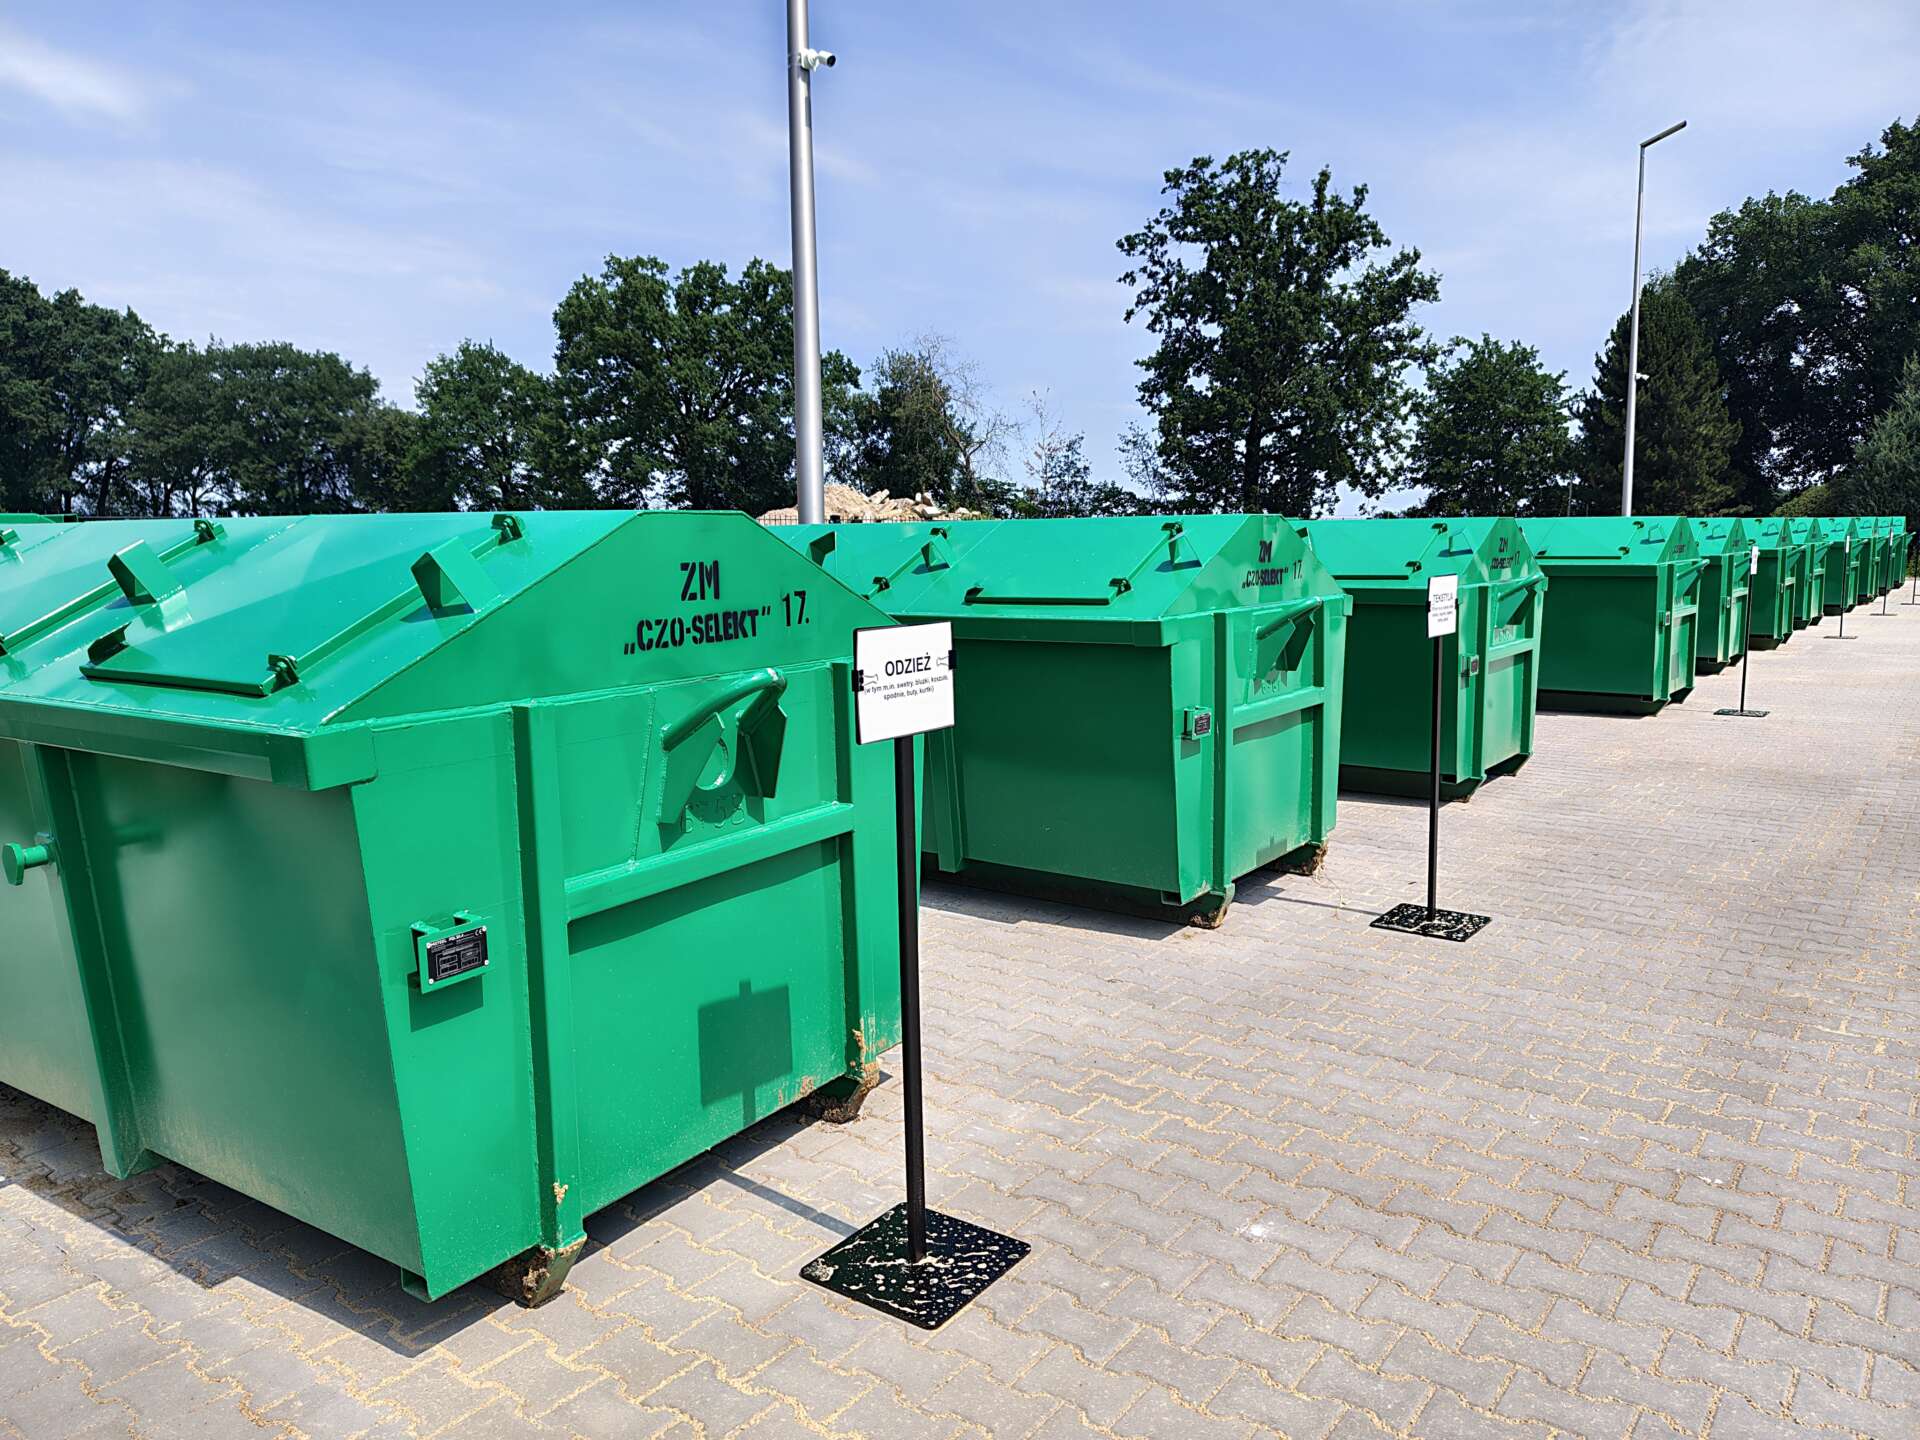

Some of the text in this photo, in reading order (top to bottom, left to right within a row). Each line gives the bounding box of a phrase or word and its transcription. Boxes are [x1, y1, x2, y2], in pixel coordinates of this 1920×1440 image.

[1258, 540, 1273, 563] ZM
[680, 560, 720, 601] ZM
[782, 590, 810, 627] 17.
[885, 651, 932, 677] ODZIEŻ
